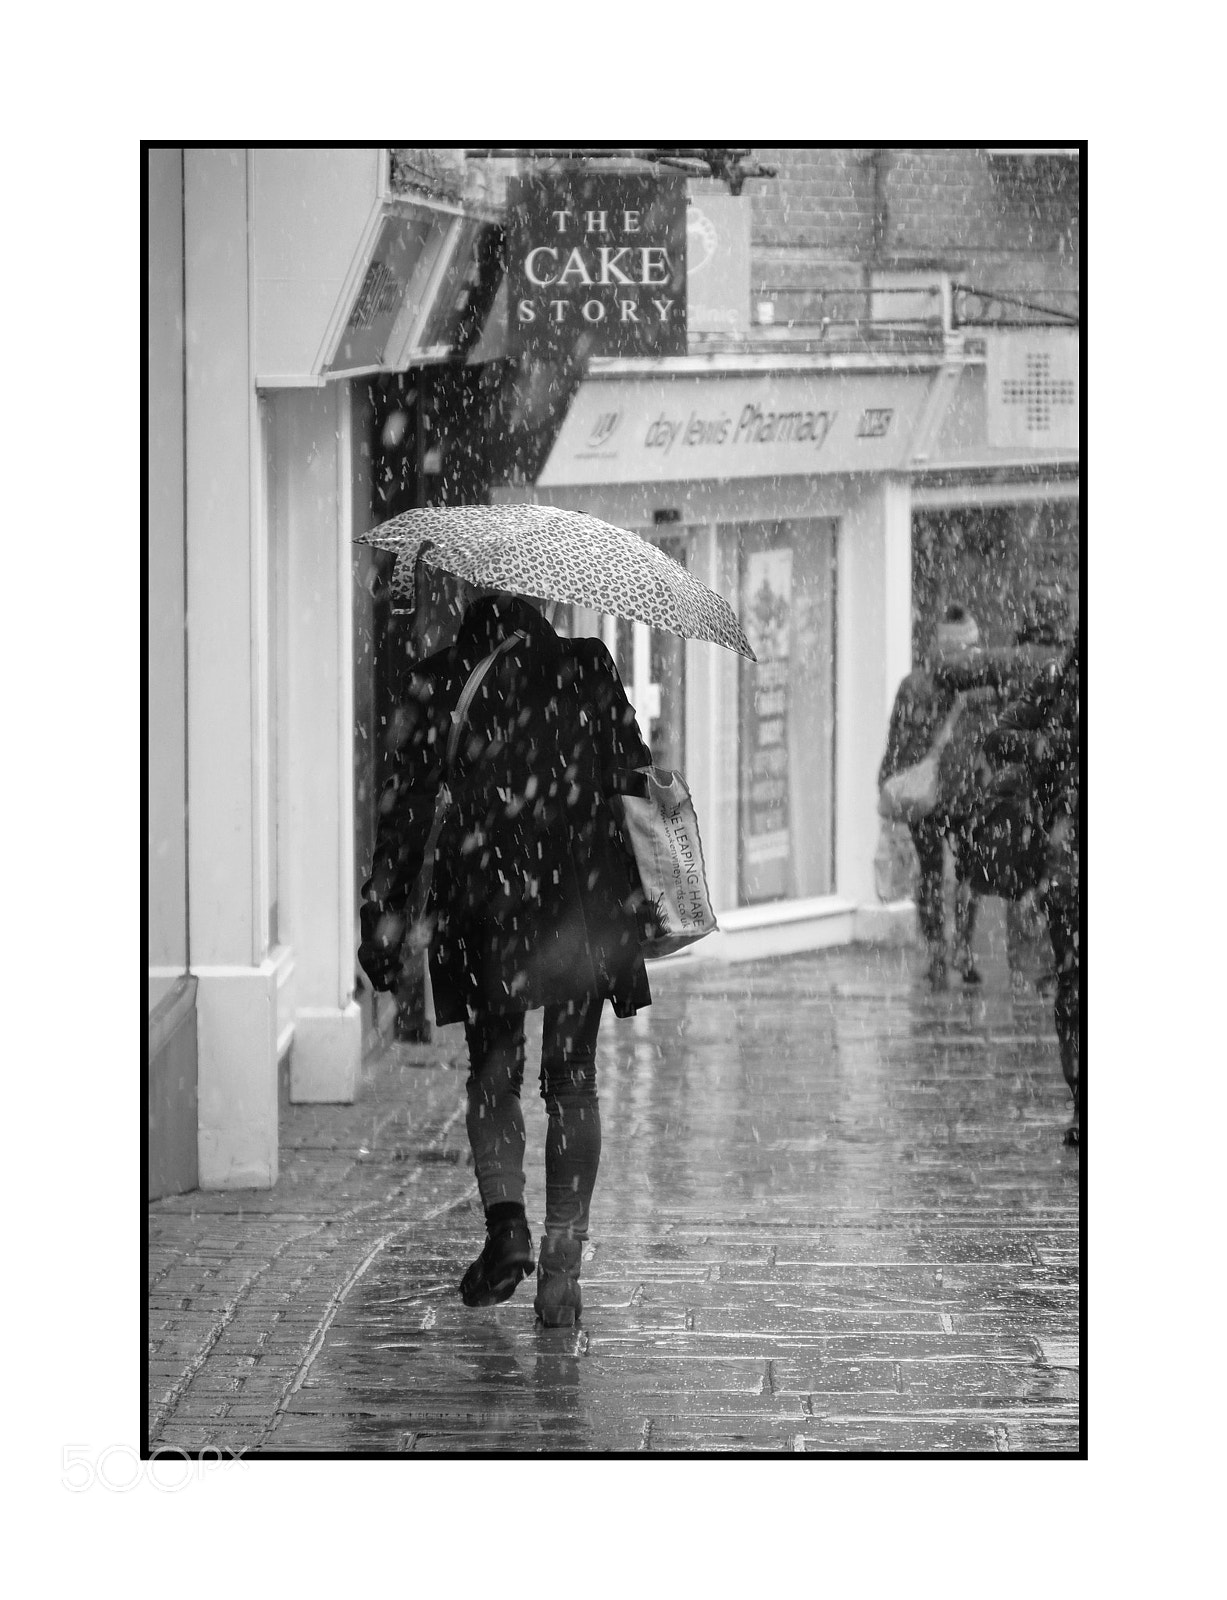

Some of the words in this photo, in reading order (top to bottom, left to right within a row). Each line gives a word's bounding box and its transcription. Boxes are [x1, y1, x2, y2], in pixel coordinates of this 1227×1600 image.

[552, 210, 641, 233] THE
[523, 246, 672, 286] CAKE
[517, 299, 674, 322] STORY
[644, 411, 683, 456] day
[681, 411, 732, 446] lewis
[732, 402, 839, 451] Pharmacy
[673, 826, 699, 885] LEAPING
[688, 889, 705, 927] HARE
